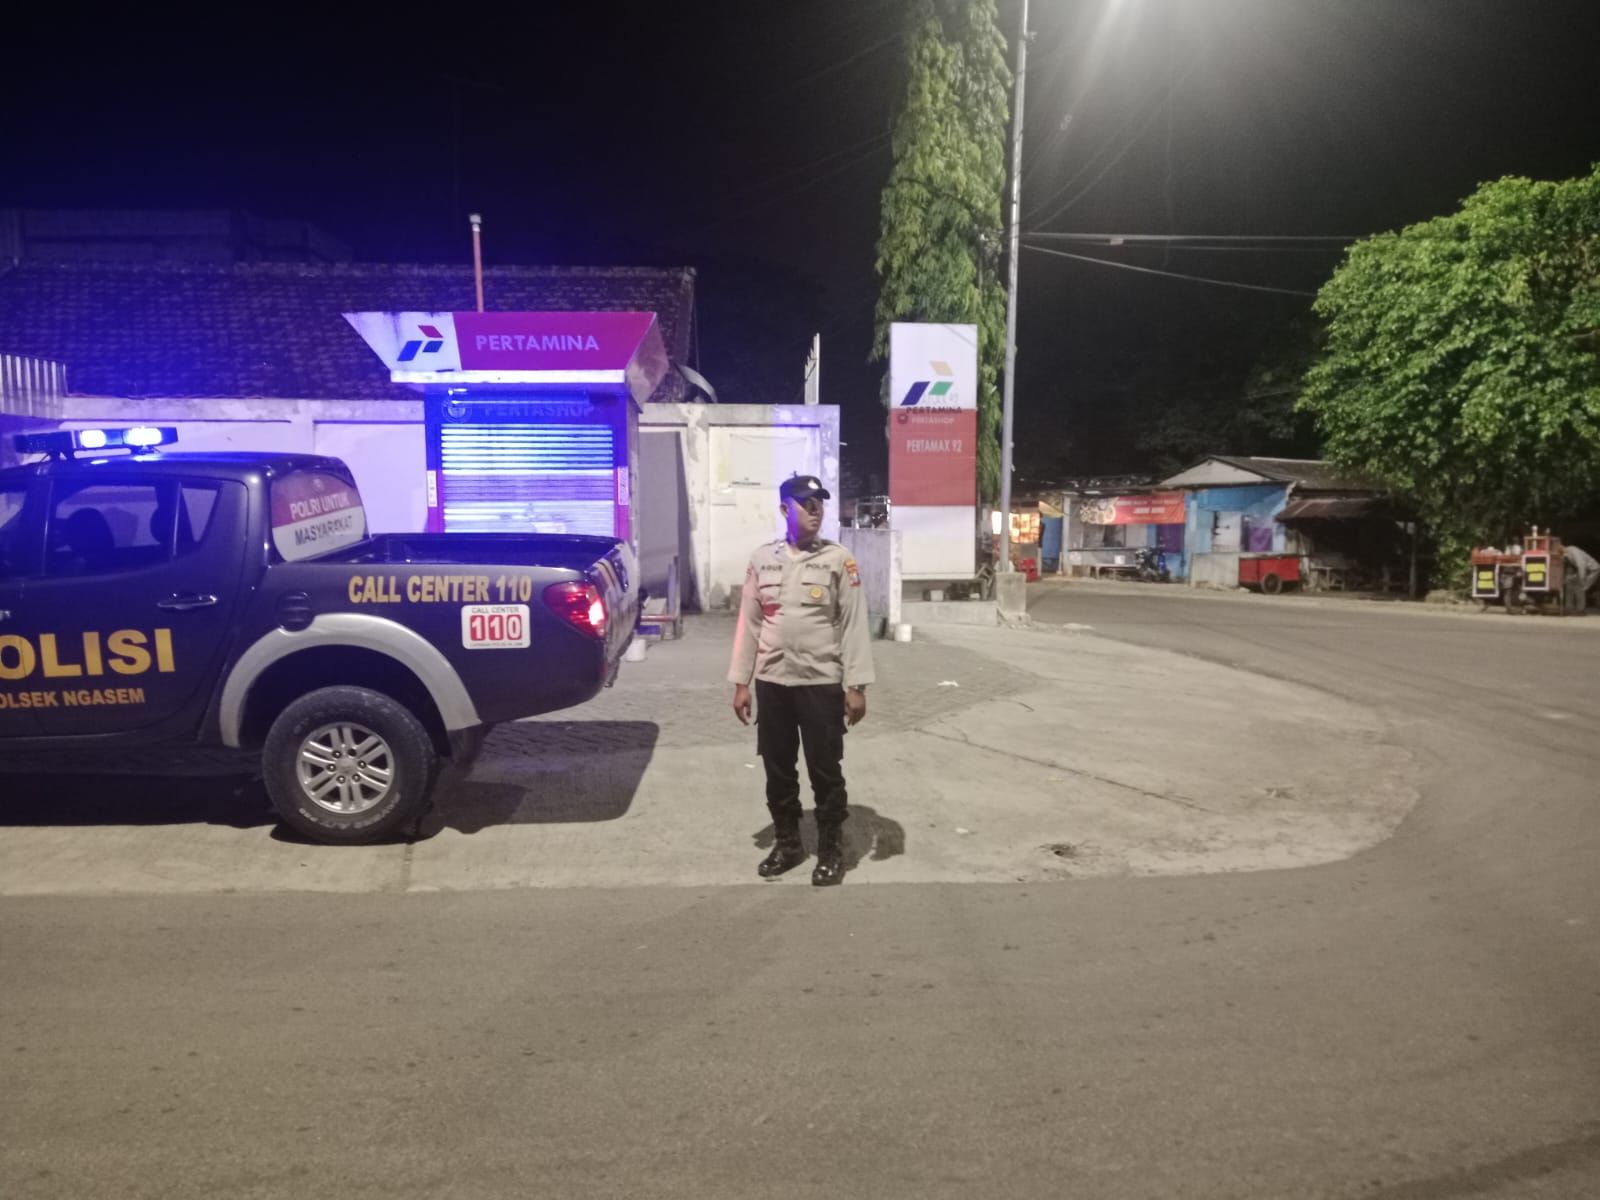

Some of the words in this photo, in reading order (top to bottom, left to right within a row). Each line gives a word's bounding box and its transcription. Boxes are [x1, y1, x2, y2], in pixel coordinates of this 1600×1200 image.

[475, 335, 600, 351] PERTAMINA
[906, 406, 962, 415] PERTAMINA
[906, 439, 950, 453] PERTAMAX
[952, 439, 963, 453] 92
[289, 497, 322, 521] POLRI
[321, 491, 351, 513] UNTUK
[348, 575, 401, 603] CALL
[407, 575, 490, 603] CENTER
[496, 575, 532, 602] 110
[471, 606, 489, 614] CALL
[471, 615, 521, 640] 110
[63, 688, 145, 706] NGASEM
